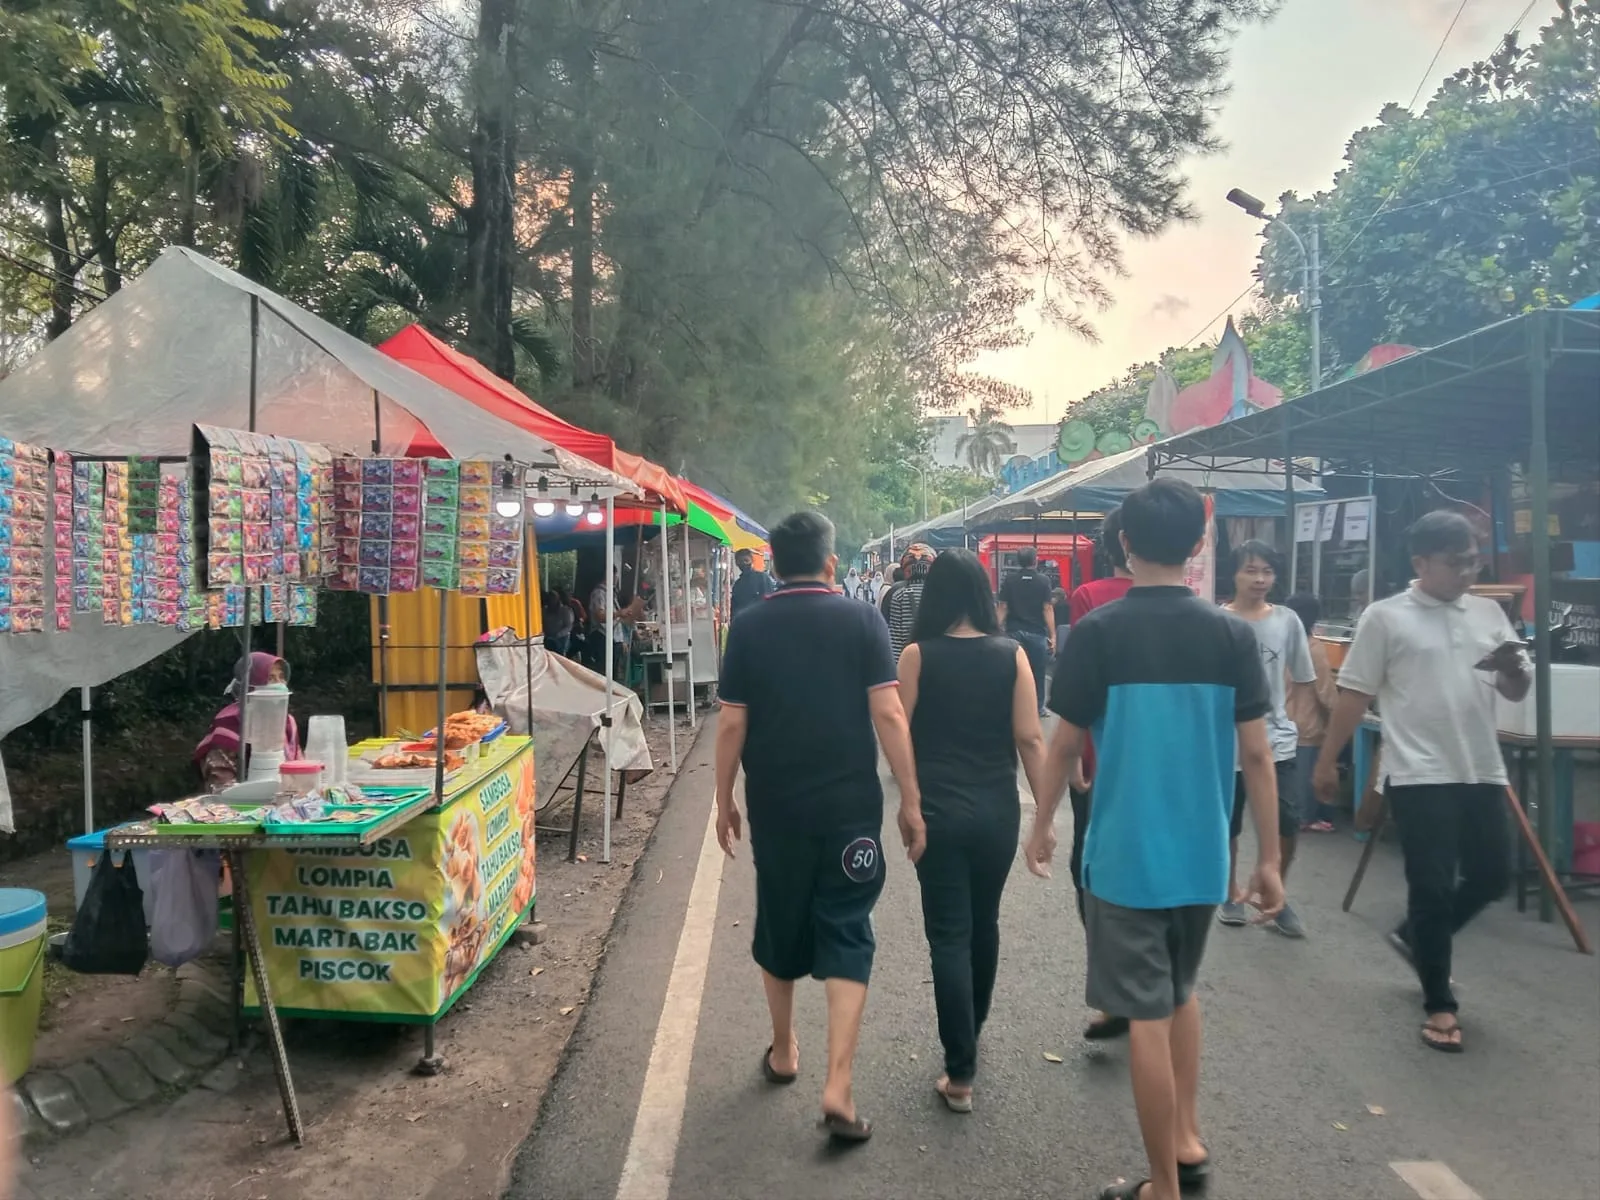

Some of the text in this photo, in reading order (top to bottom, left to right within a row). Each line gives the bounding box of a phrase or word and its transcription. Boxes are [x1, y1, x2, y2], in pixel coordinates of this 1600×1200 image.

[479, 772, 512, 812] SAMBOSA
[486, 806, 510, 842] LOMPIA
[481, 830, 520, 885] TAHU BAKSO
[852, 849, 873, 868] 50
[298, 867, 393, 889] LOMPIA
[267, 895, 426, 921] TAHU BAKSO
[274, 927, 417, 951] MARTABAK
[300, 959, 391, 982] PISCOK
